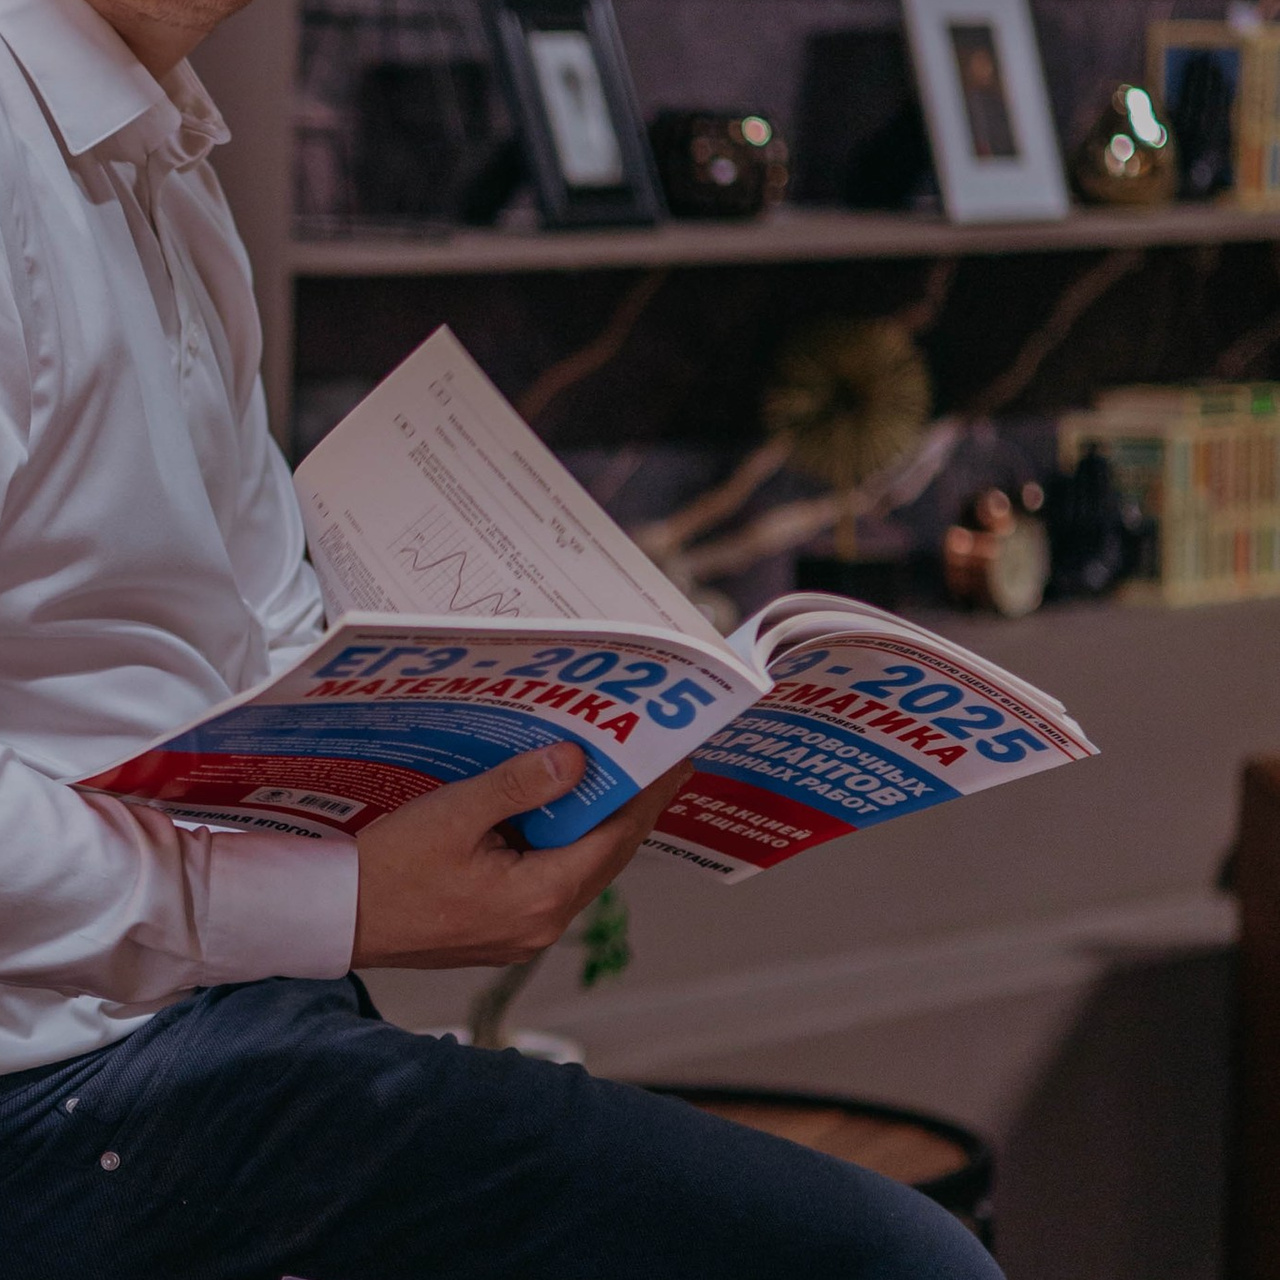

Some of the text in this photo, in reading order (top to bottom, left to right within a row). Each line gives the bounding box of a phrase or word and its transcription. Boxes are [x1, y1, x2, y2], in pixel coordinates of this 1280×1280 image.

[304, 677, 641, 744] МАТЕМАТИКА
[310, 646, 468, 678] ЕГЭ
[503, 647, 717, 730] 2025
[473, 697, 536, 713] УРОВЕНЬ
[754, 702, 867, 734] ИЛЬНЫЙ УРОВЕНЬ
[772, 649, 830, 681] Э
[849, 664, 1049, 763] 2025
[960, 673, 1002, 698] ОЦЕНКУ
[1001, 697, 1035, 720] ФГБНУ
[730, 717, 936, 798] ЕНИРОВОЧНЫХ
[760, 681, 969, 768] ЕМАТИКА
[692, 748, 880, 815] ИОННЫХ РАБОТ
[705, 730, 908, 807] АРИАНТОВ
[163, 806, 254, 825] СТВЕННАЯ
[678, 792, 814, 841] РЕДАКЦИЕЙ
[693, 812, 791, 849] ЯЩЕНКО
